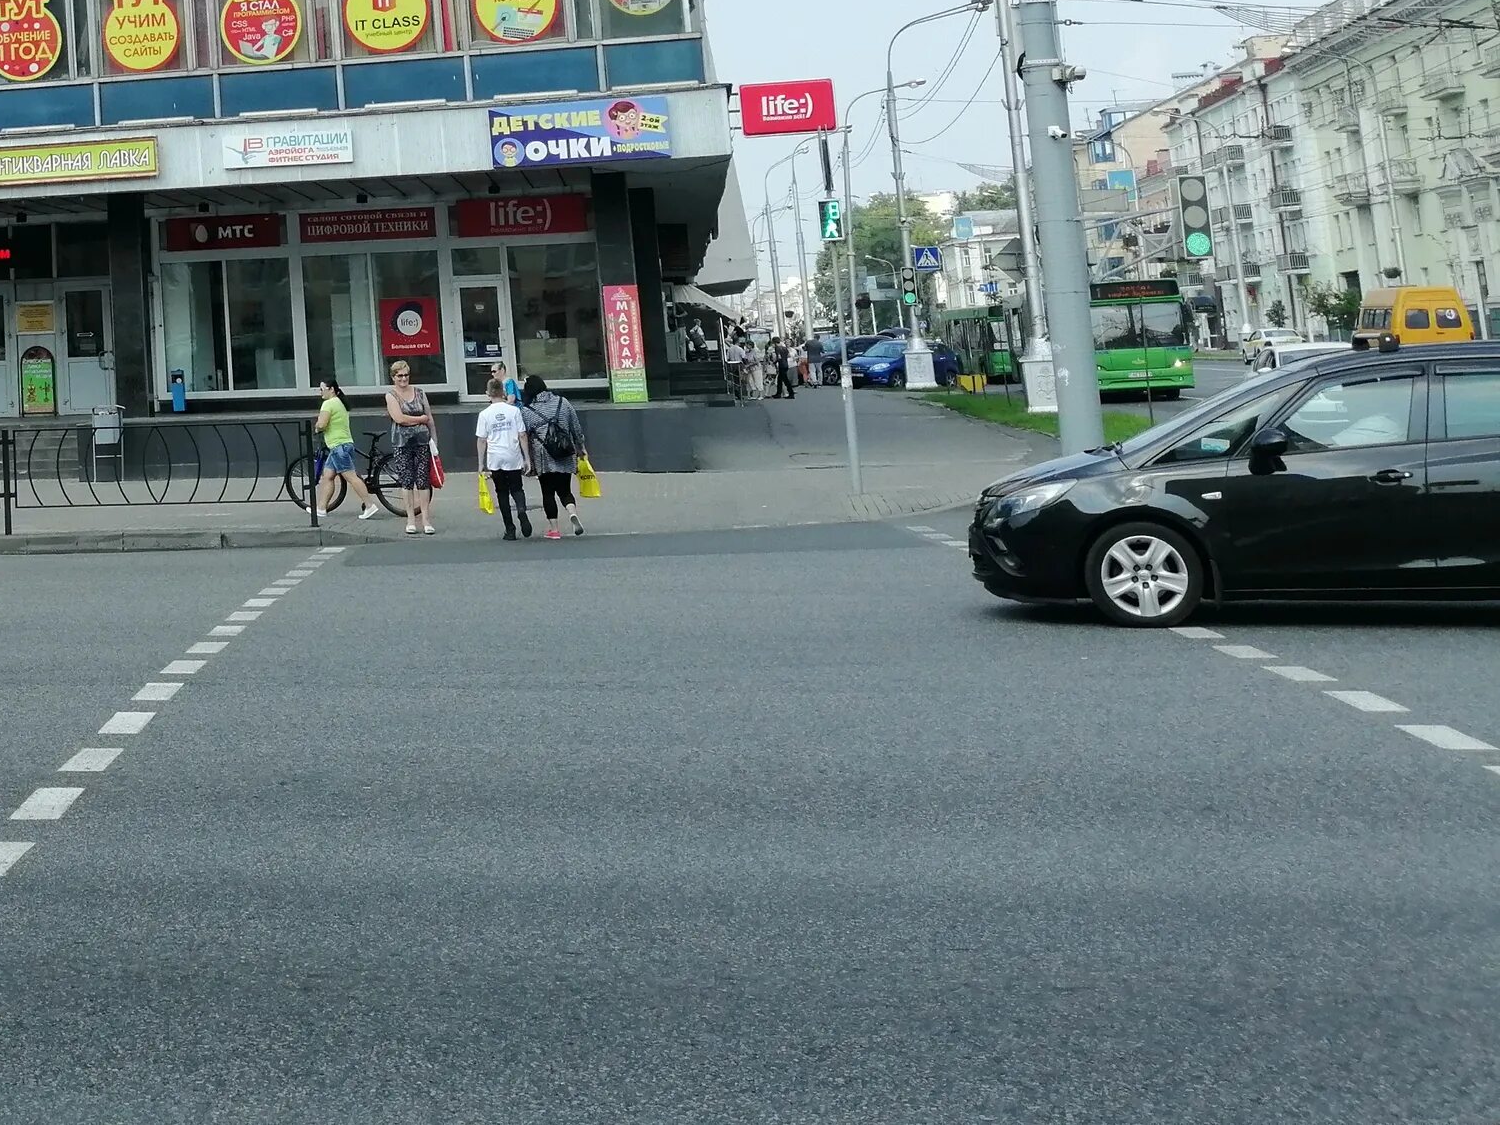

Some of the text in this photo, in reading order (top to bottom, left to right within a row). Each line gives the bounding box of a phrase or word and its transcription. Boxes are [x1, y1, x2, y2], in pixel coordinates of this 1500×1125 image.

[233, 8, 290, 18] ПРОГРАММИСТОМ
[240, 0, 280, 11] Я СТАЛ
[115, 13, 166, 30] УЧИМ
[232, 20, 248, 28] CSS
[355, 15, 420, 31] IT CLASS
[109, 31, 175, 46] СОЗДАВАТЬ
[243, 33, 261, 41] Java
[11, 42, 53, 61] ГОД
[123, 44, 162, 58] САЙТЫ
[761, 93, 813, 119] life:)
[491, 110, 602, 136] ДЕТСКИЕ
[266, 132, 348, 148] ГРАВИТАЦИИ
[268, 147, 314, 156] АЭРОЙОГА
[525, 136, 612, 162] ОЧКИ
[99, 147, 150, 169] ЛАВКА
[268, 153, 339, 163] ФИТНЕС СТУДИЯ
[307, 214, 338, 223] салон
[340, 211, 383, 222] сотовой
[385, 211, 417, 219] связи
[489, 198, 552, 231] life:)
[217, 225, 254, 239] МТС
[307, 220, 429, 236] ЦИФРОВОЙ ТЕХНИКИ
[401, 317, 419, 328] life:)
[616, 301, 634, 368] МАССАЖ
